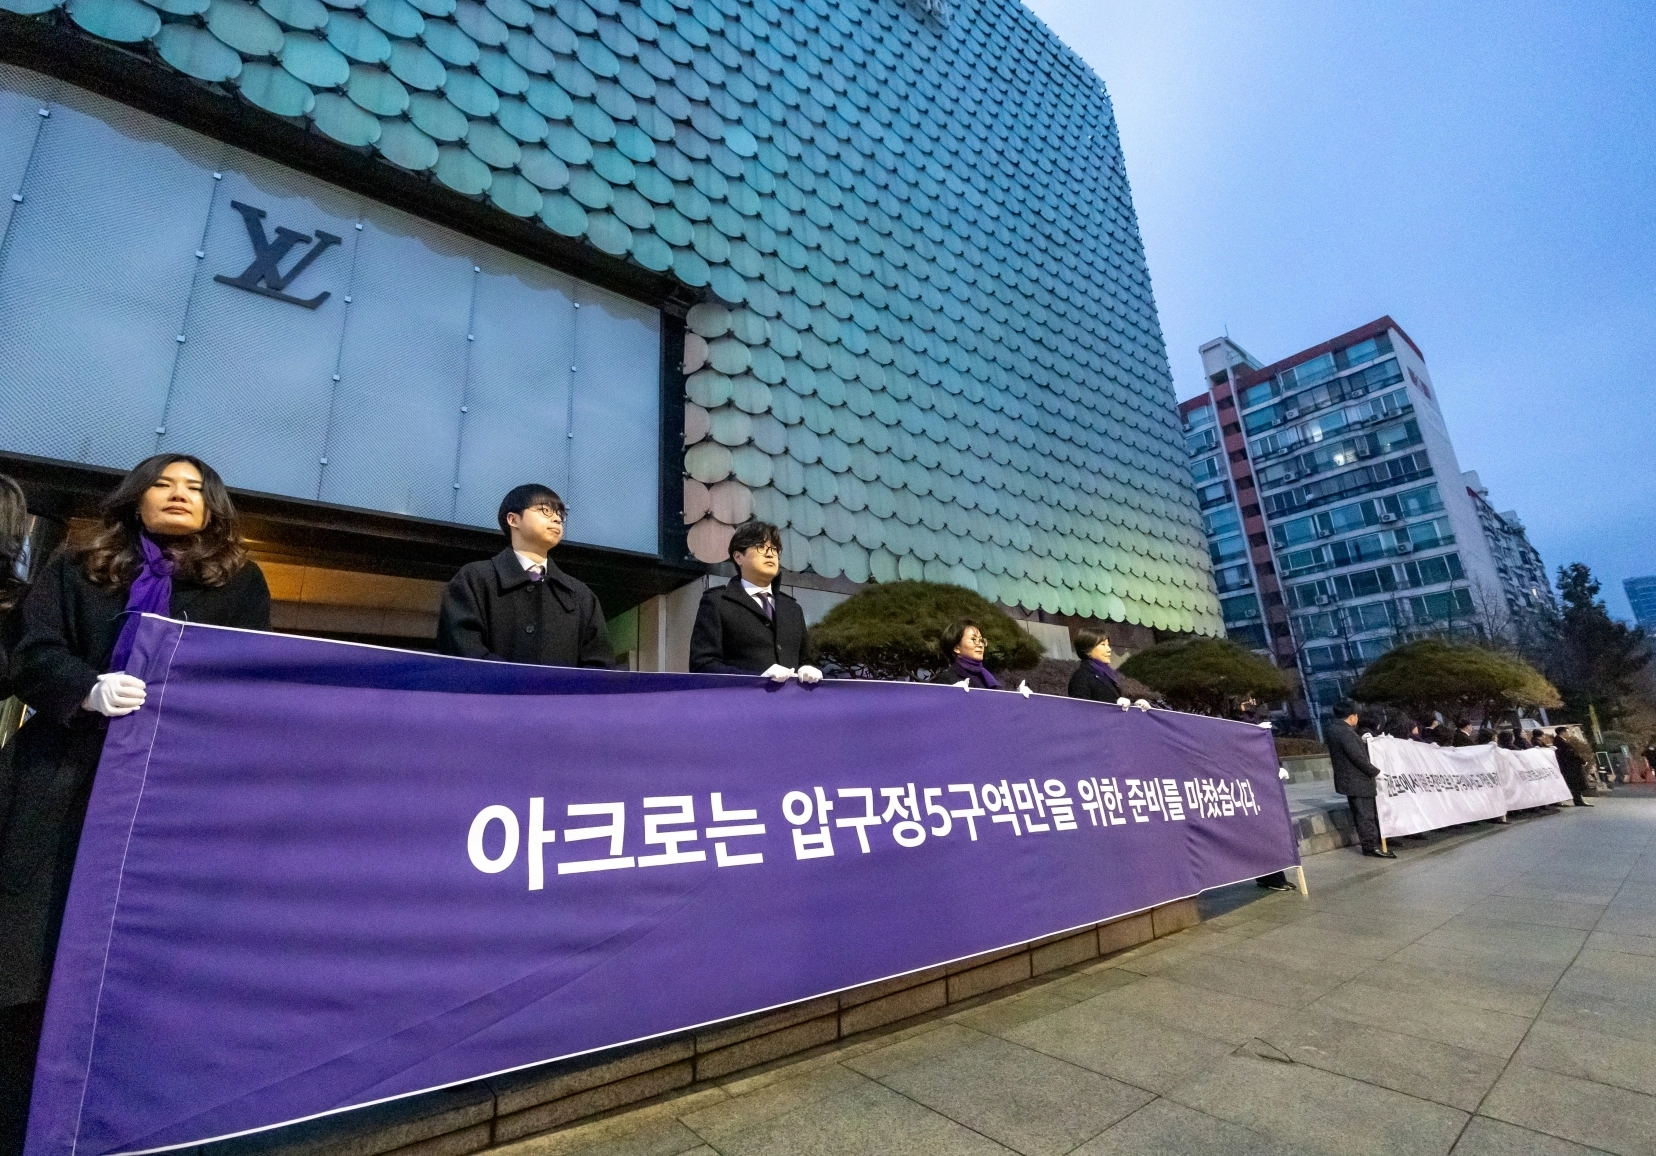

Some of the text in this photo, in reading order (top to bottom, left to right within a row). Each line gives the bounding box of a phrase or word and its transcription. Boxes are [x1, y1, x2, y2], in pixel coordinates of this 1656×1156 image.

[213, 199, 342, 310] LV
[467, 776, 1261, 891] 아크로는 압구정5구역만을 위한 준비를 마쳤습니다.
